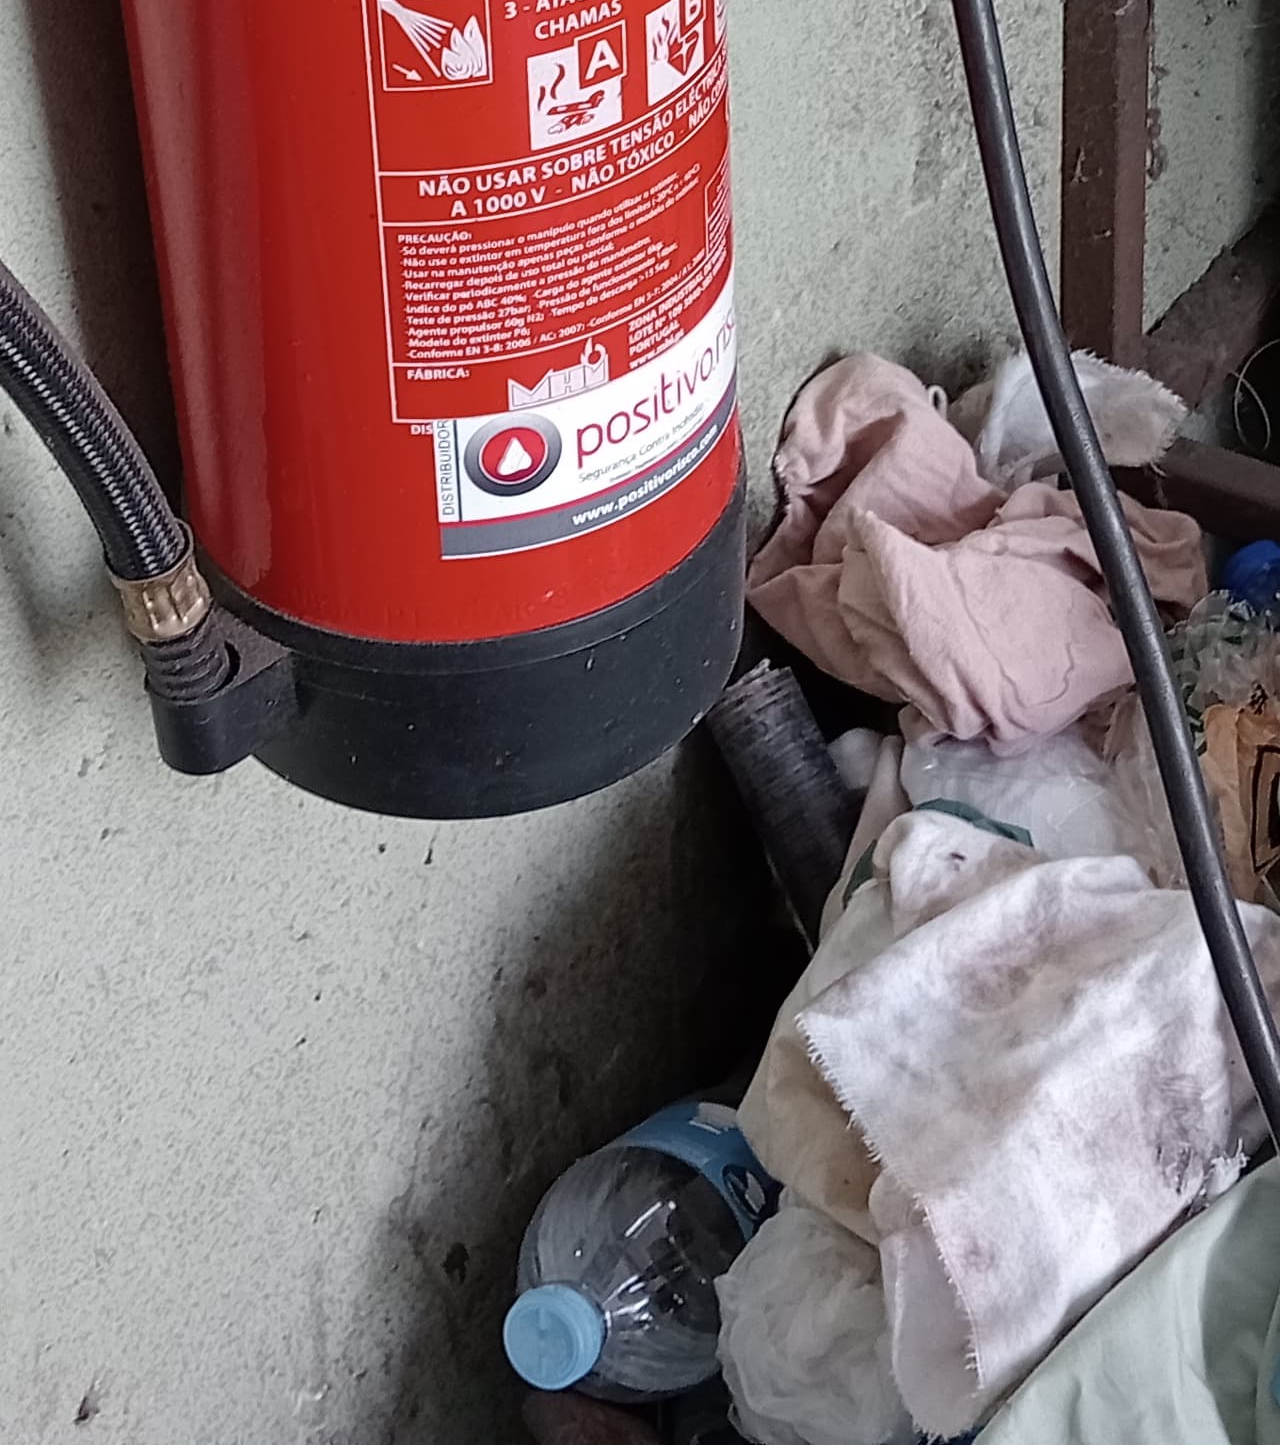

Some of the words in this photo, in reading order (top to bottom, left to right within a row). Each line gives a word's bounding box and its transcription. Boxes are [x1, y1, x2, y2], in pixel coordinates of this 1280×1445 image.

[504, 1, 517, 19] 3
[584, 38, 620, 80] A
[418, 176, 471, 196] NÃO
[475, 165, 537, 193] USAR
[540, 143, 607, 180] SOBRE
[609, 109, 673, 155] TENSÃO
[450, 200, 467, 218] A
[473, 193, 527, 215] 1000
[529, 186, 546, 204] V
[570, 165, 615, 195] NÃO
[616, 131, 675, 175] TÓXICO
[398, 231, 472, 244] PRECAUÇÃO:
[428, 257, 448, 267] use
[449, 257, 458, 266] o
[459, 252, 502, 264] extintor
[504, 248, 522, 258] em
[523, 230, 586, 254] temperatura
[607, 215, 624, 228] dos
[459, 238, 516, 254] pressionar
[517, 236, 526, 245] o
[526, 222, 576, 241] manípulo
[576, 209, 613, 229] quando
[431, 269, 446, 278] na
[447, 261, 516, 277] manutenção
[517, 252, 555, 268] apenas
[555, 243, 584, 259] peças
[465, 272, 503, 287] depois
[505, 271, 519, 281] de
[520, 267, 540, 278] uso
[541, 258, 566, 273] total
[566, 256, 581, 266] ou
[441, 302, 457, 313] do
[475, 297, 499, 309] ABC
[566, 280, 579, 290] do
[580, 267, 613, 286] agente
[452, 280, 538, 301] periodicamente
[585, 260, 599, 271] do
[436, 314, 452, 324] de
[578, 287, 591, 298] de
[628, 309, 657, 332] ZONA
[449, 321, 503, 338] propulsor
[452, 335, 467, 346] do
[468, 331, 513, 345] extintor
[628, 321, 654, 345] LOTE
[628, 320, 681, 356] PORTUGAL
[465, 345, 481, 356] EN
[407, 367, 470, 380] FÁBRICA:
[437, 420, 455, 515] DISTRIBUIDOR
[572, 423, 719, 527] www.positivorisco.com
[578, 453, 637, 483] Segurança
